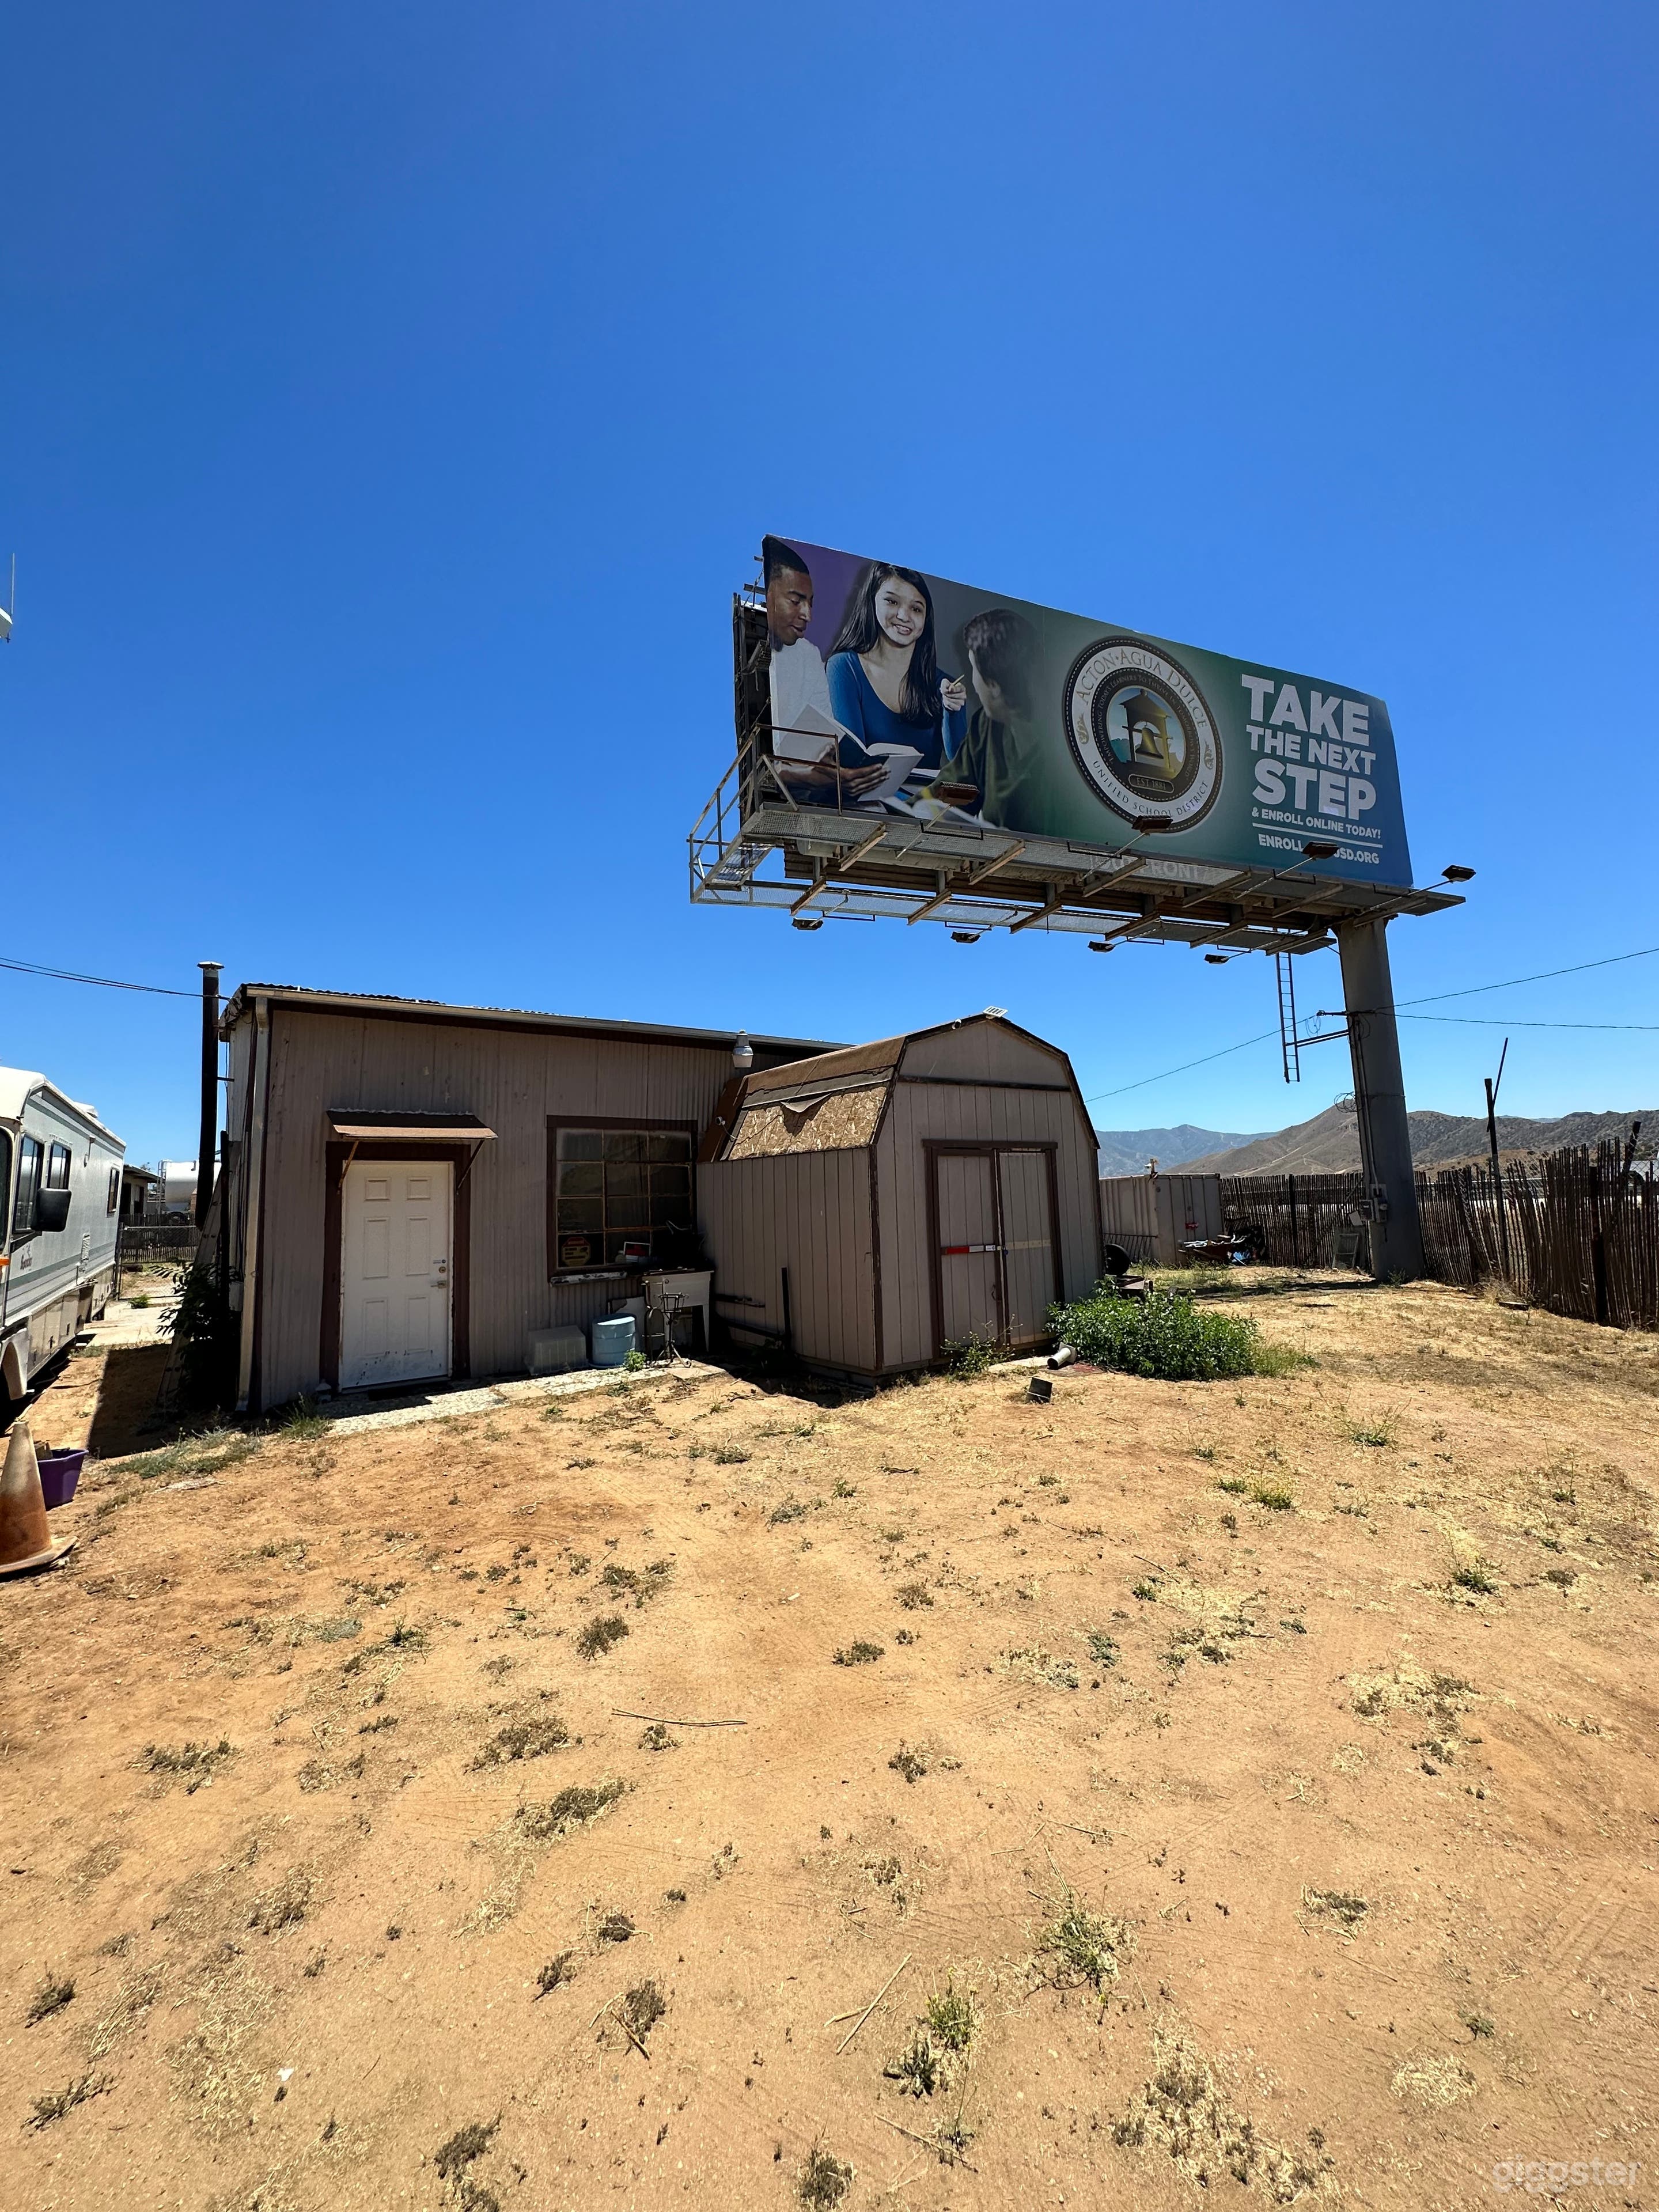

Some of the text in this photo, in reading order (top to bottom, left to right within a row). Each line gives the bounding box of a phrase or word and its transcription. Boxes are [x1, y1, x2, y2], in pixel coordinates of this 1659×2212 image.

[1076, 648, 1207, 728] ACTON AGUA DULCE
[1241, 674, 1369, 746] TAKE
[1246, 725, 1376, 775] THE NEXT
[1093, 760, 1129, 804] UNIFIED
[1176, 781, 1208, 816] DISTRICT
[1137, 778, 1166, 791] EST 1881
[1252, 758, 1376, 820] STEP
[1252, 807, 1381, 839] & ENROLL ONLINE TODAY!
